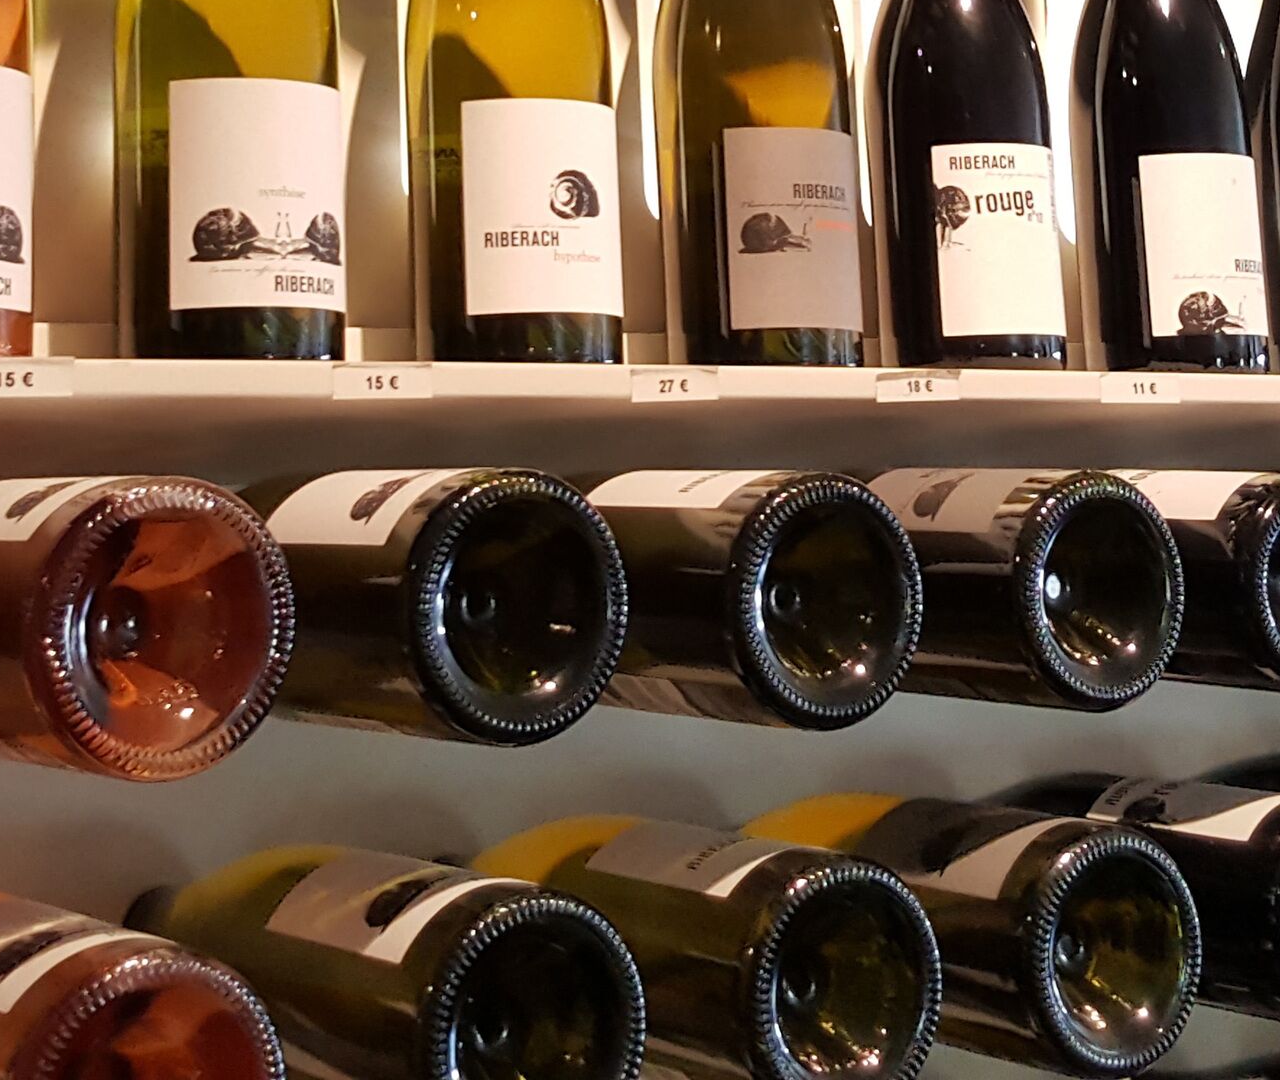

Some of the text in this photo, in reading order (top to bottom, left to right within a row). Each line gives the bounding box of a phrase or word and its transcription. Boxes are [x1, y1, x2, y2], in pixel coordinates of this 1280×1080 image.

[949, 154, 1016, 171] RIBERACH
[793, 183, 846, 202] RIBERACH
[974, 190, 1035, 216] rouge
[484, 230, 560, 249] RIBERACH
[274, 275, 336, 296] RIBERACH
[22, 371, 34, 387] €
[366, 375, 400, 390] 15 €
[658, 379, 689, 393] 27 €
[907, 380, 933, 393] 18 €
[1133, 382, 1157, 394] 11 €
